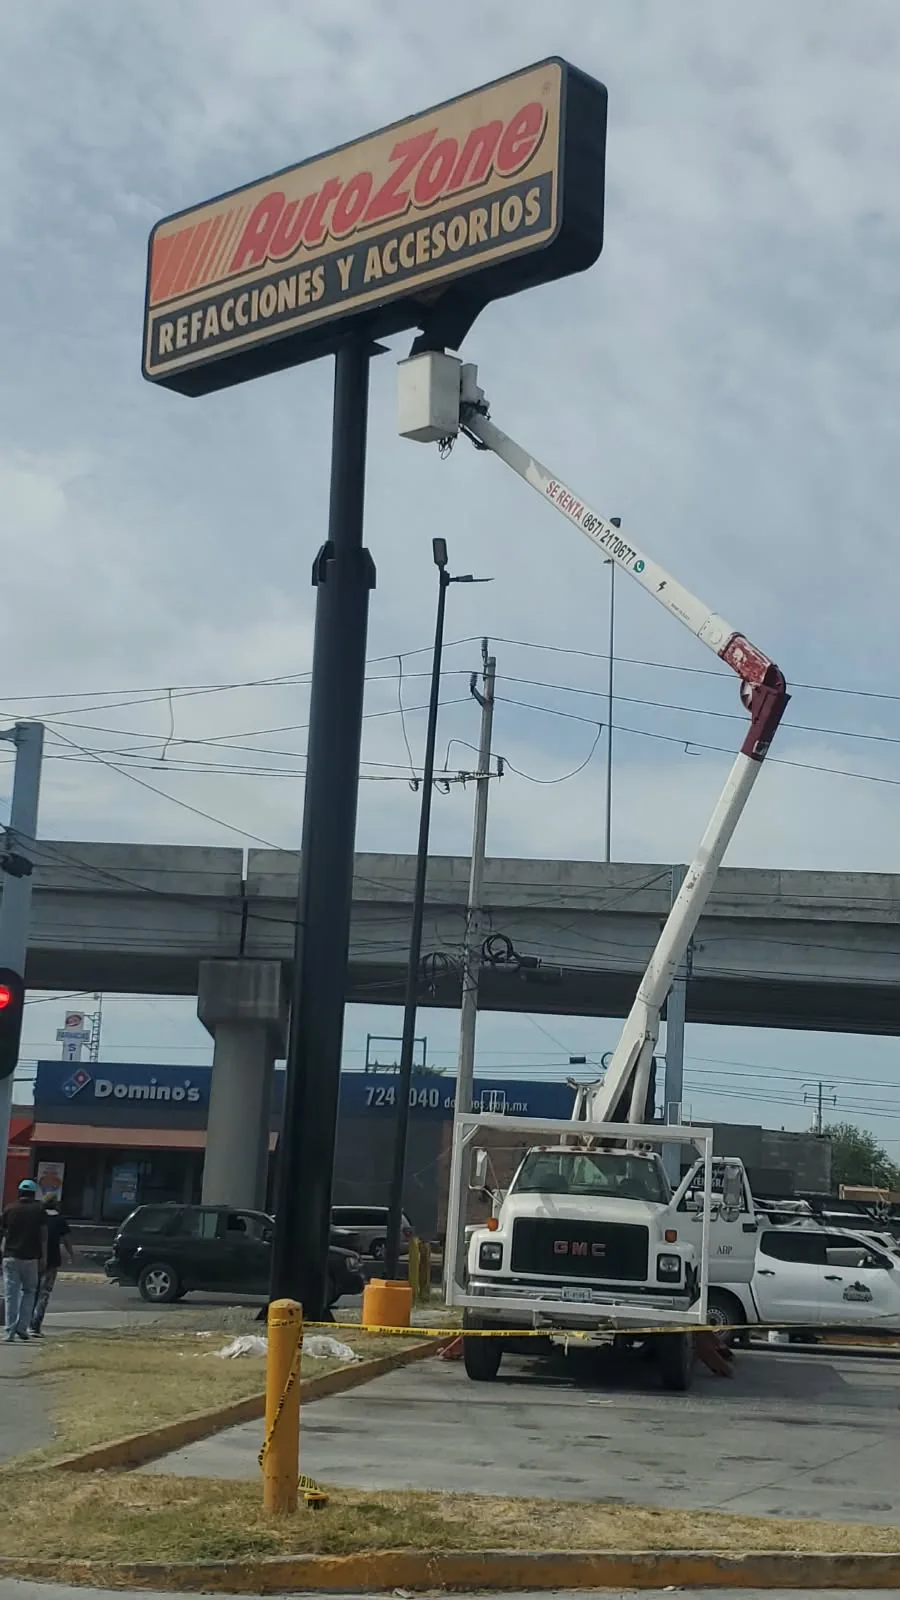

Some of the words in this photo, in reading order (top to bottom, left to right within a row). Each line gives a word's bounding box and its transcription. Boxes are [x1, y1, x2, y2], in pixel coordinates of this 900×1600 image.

[228, 101, 546, 273] AutoZone
[159, 264, 325, 356] REFACCIONES
[337, 254, 354, 291] Y
[363, 188, 542, 284] ACCESORIOS
[546, 481, 560, 499] SE
[556, 490, 584, 523] RENTA
[581, 511, 603, 538] (867)
[600, 529, 637, 566] 2170677
[94, 1078, 200, 1102] Domino's
[553, 1240, 606, 1257] GMC
